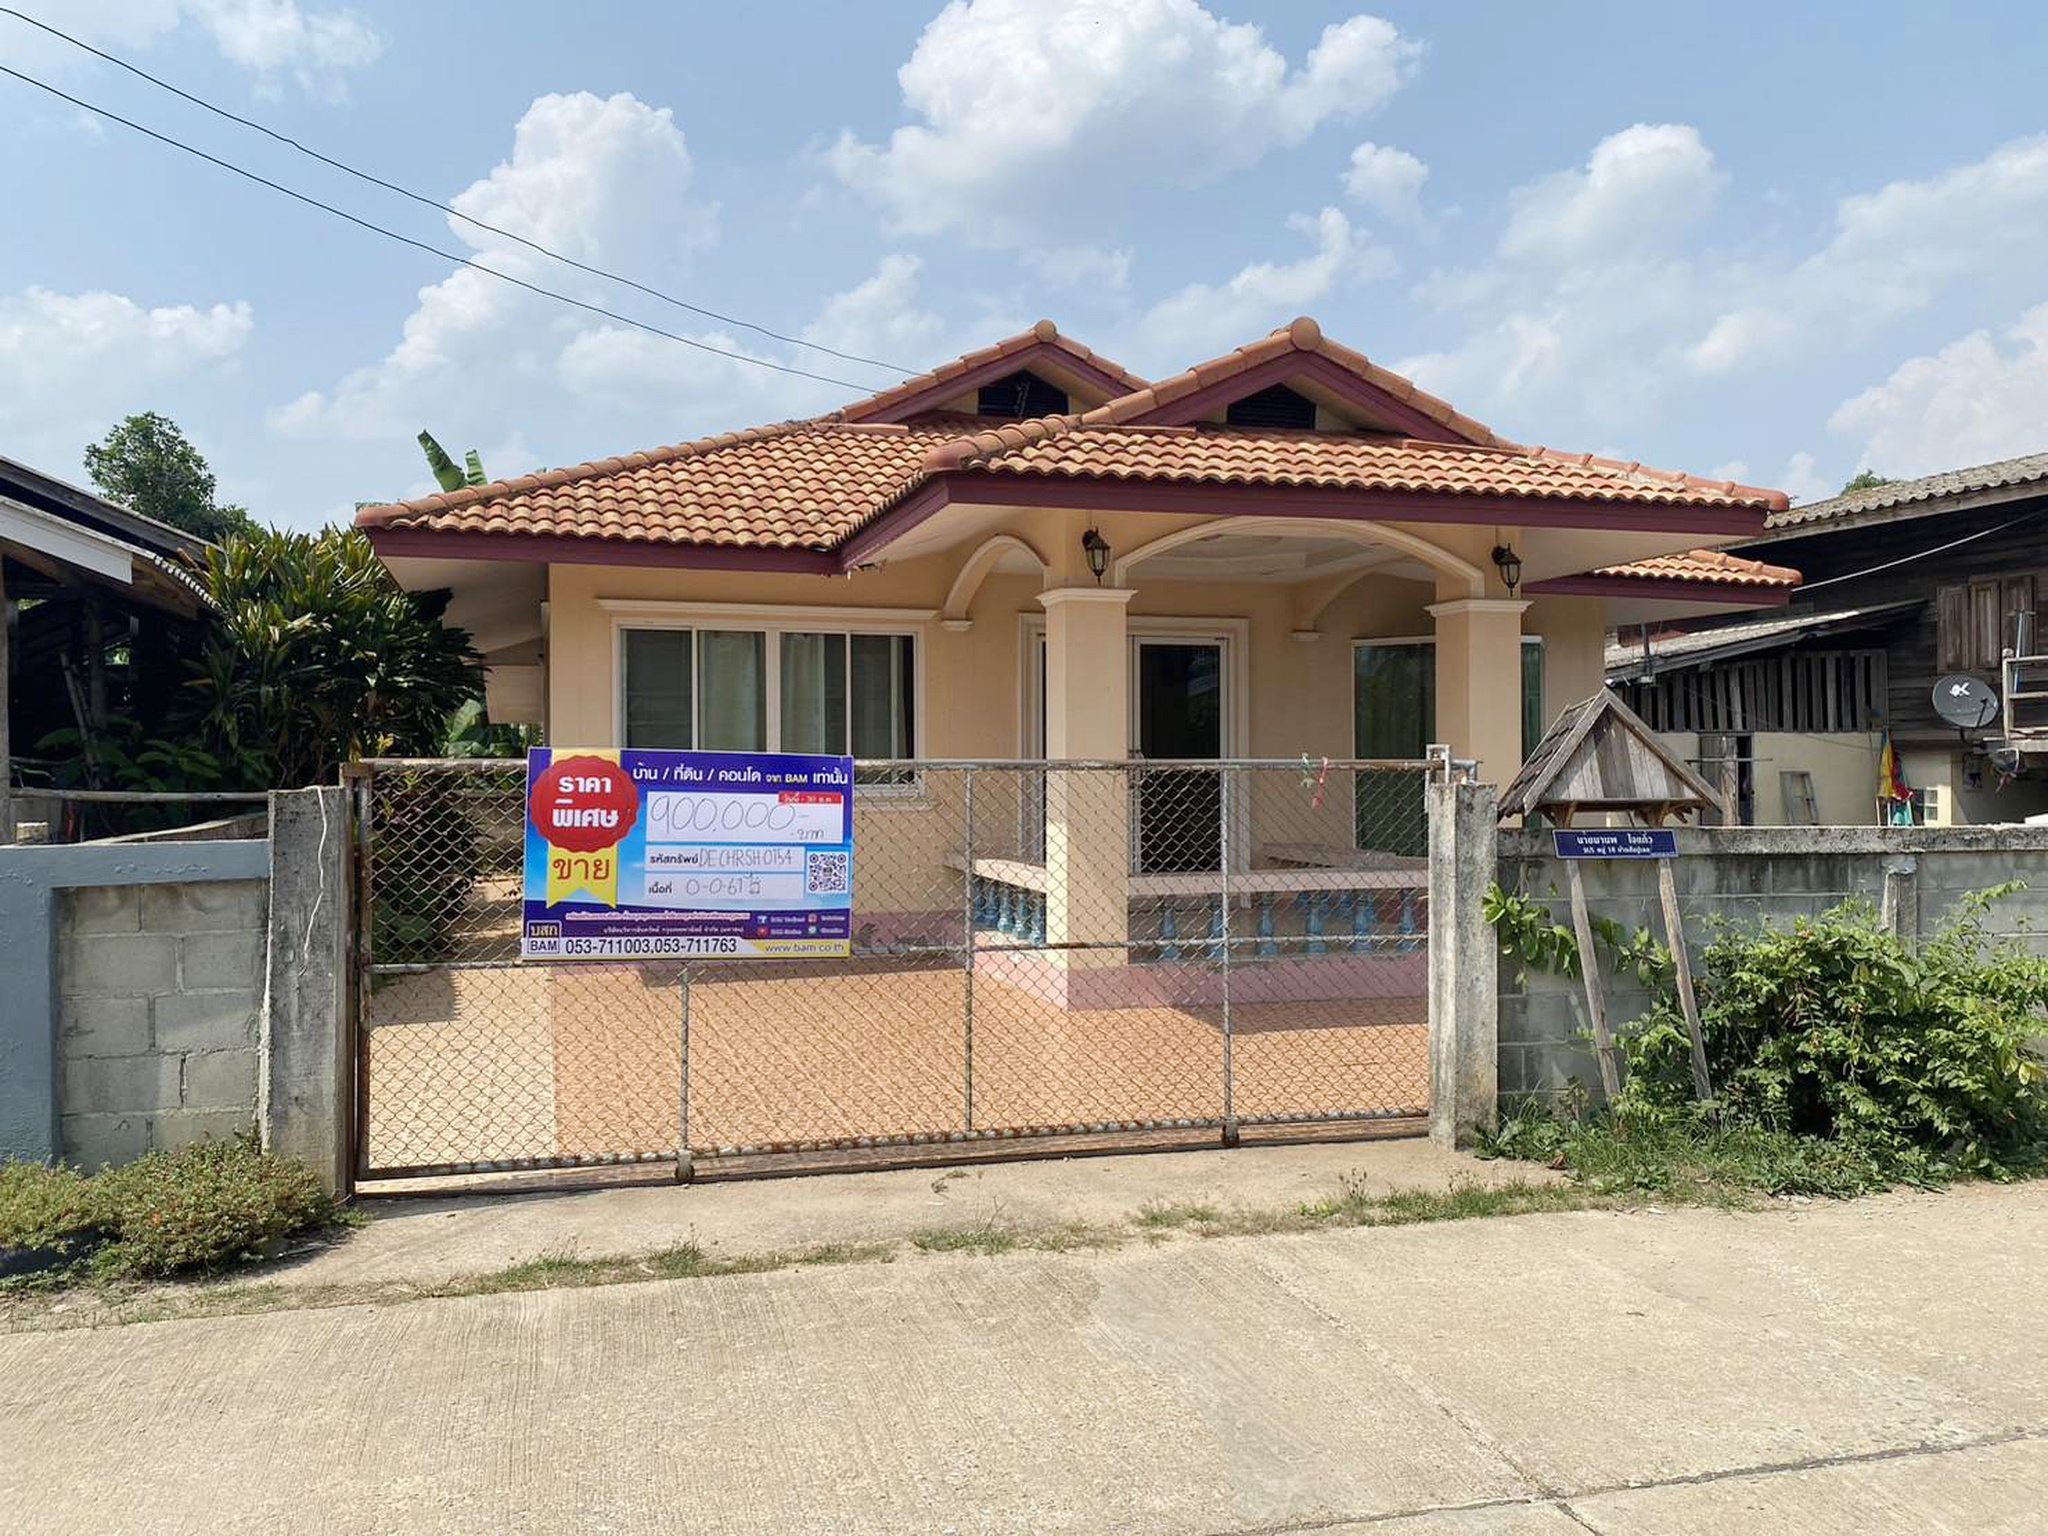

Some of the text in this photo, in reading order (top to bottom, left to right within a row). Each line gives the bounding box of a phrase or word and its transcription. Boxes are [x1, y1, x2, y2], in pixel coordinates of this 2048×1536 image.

[632, 762, 658, 781] บ้าน
[674, 763, 703, 781] ที่ดิน
[719, 766, 761, 783] คอนโด
[785, 774, 808, 784] BAM
[813, 766, 849, 785] เท่านั้น
[558, 776, 612, 793] ราคา
[553, 798, 619, 828] พิเศษ
[650, 852, 698, 865] รหัสทรัพย์
[553, 858, 610, 881] ขาย
[649, 880, 672, 894] เนื้อที่
[530, 925, 558, 937] บสก
[530, 940, 558, 951] BAM
